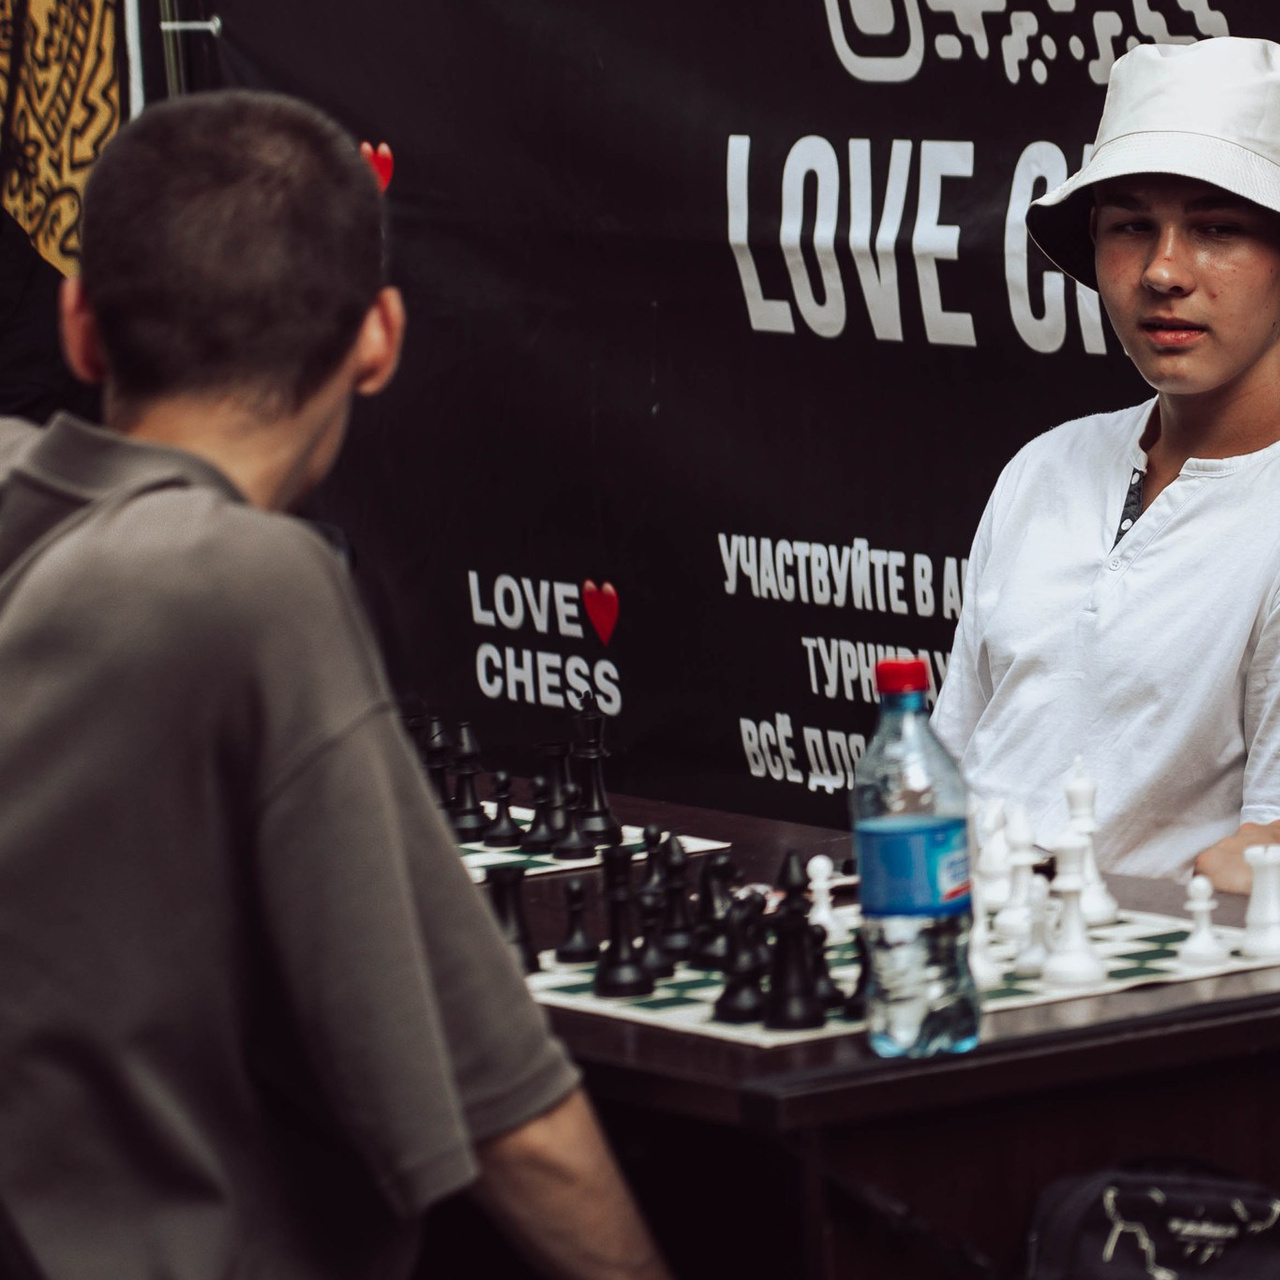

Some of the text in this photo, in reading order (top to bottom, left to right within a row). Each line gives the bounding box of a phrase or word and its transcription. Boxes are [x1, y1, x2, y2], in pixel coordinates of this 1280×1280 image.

[725, 133, 978, 348] LOVE
[467, 569, 584, 639] LOVE
[716, 531, 910, 616] УЧАСТВУЙТЕ
[912, 551, 939, 618] В
[475, 642, 623, 716] CHESS
[738, 711, 868, 796] ВСЁ ДЛЯ
